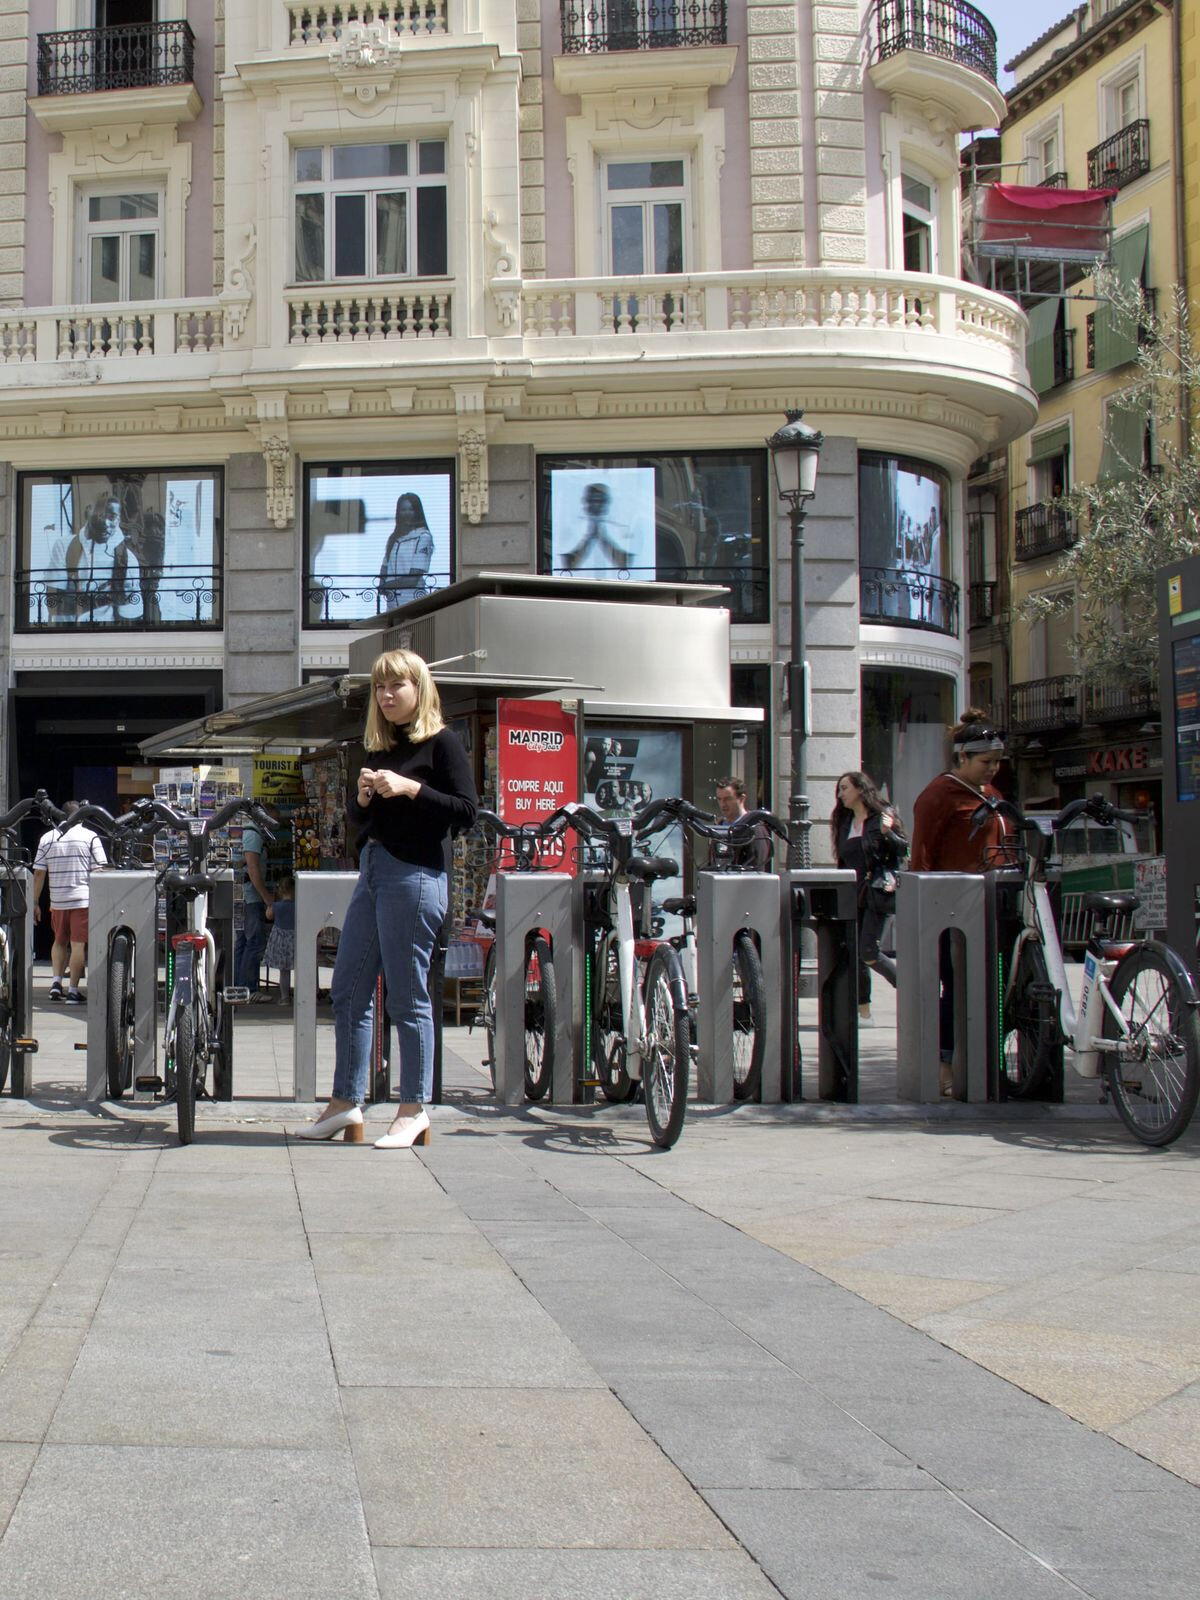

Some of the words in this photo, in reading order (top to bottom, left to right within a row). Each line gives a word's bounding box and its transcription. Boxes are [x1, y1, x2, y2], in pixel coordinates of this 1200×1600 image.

[509, 730, 563, 744] MADRID
[528, 740, 542, 753] City
[543, 741, 561, 751] Tour
[255, 760, 292, 770] TOURIST
[507, 780, 540, 792] COMPRE
[543, 780, 564, 795] AQUI
[515, 798, 532, 810] BUY
[535, 798, 556, 810] HERE
